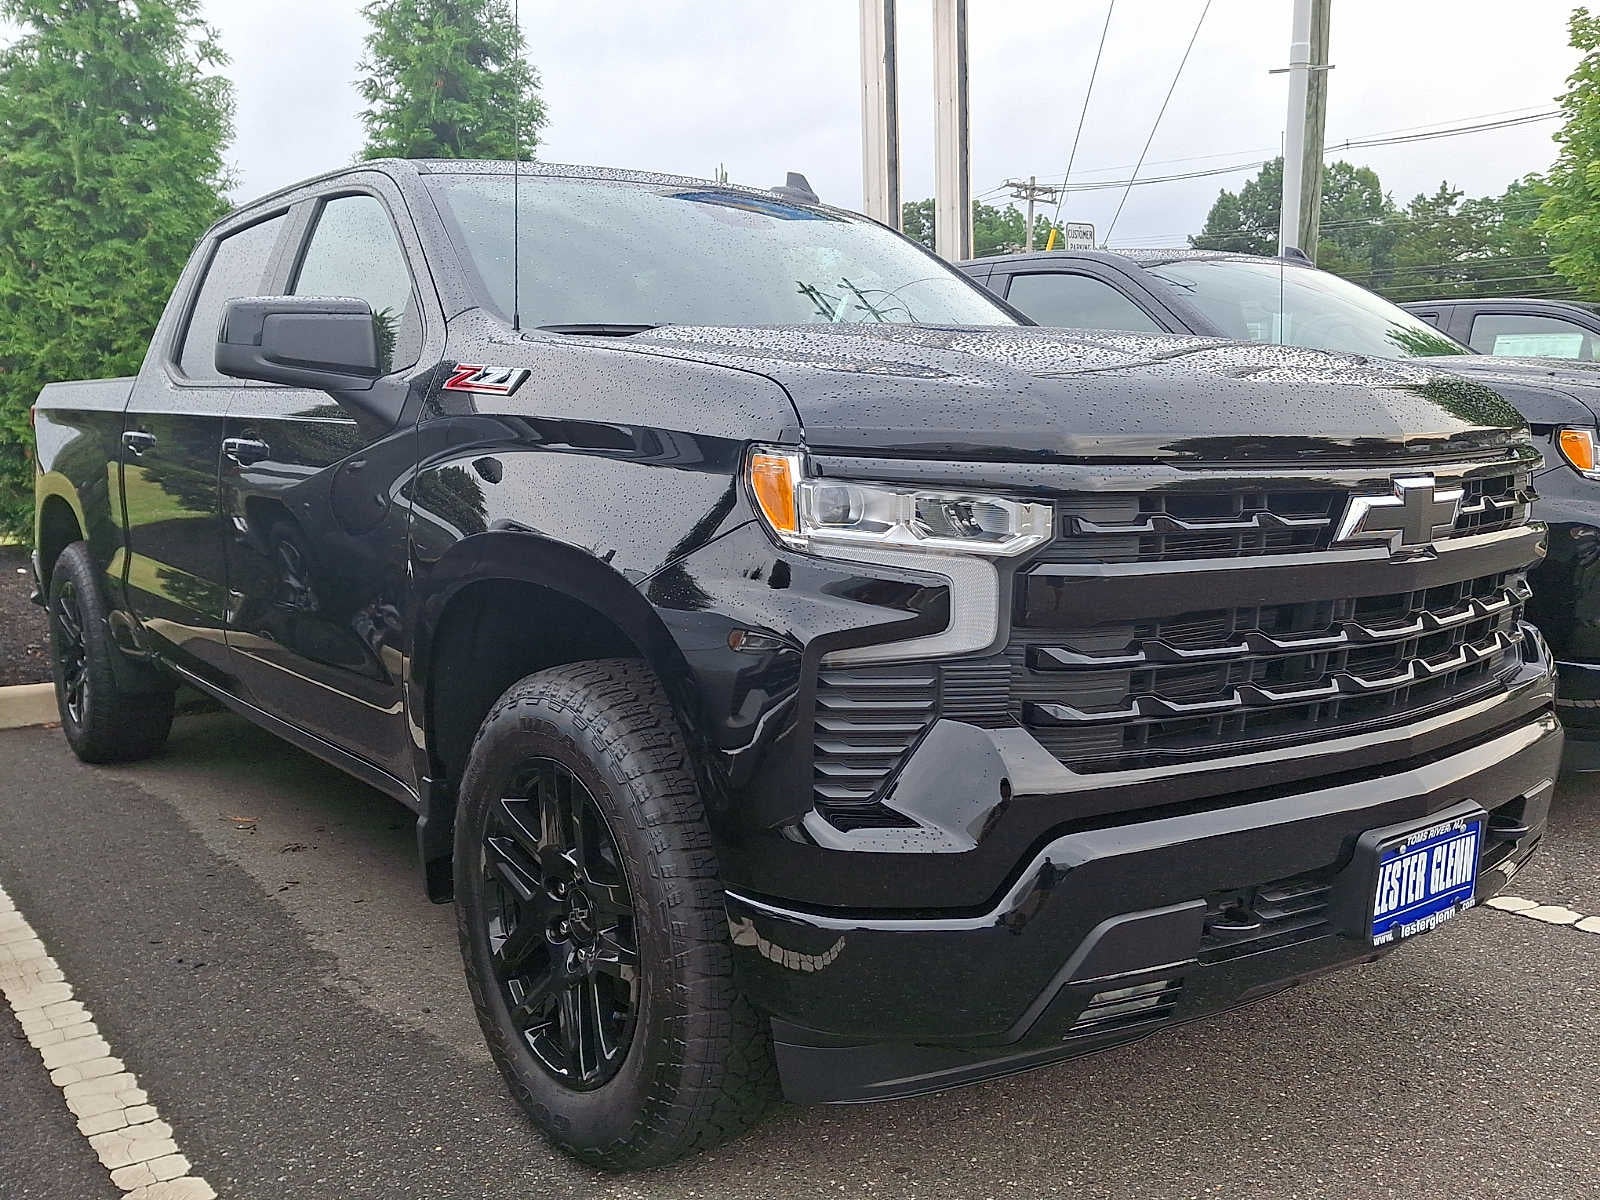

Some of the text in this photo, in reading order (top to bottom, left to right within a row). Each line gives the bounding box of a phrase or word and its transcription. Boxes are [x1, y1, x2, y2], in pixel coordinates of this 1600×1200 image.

[1068, 229, 1092, 240] CUSTOMER
[442, 362, 531, 397] Z71
[1407, 831, 1428, 847] TOMS
[1373, 834, 1476, 917] LESTER GLENN
[1373, 898, 1476, 946] www. lesterglenn .com
